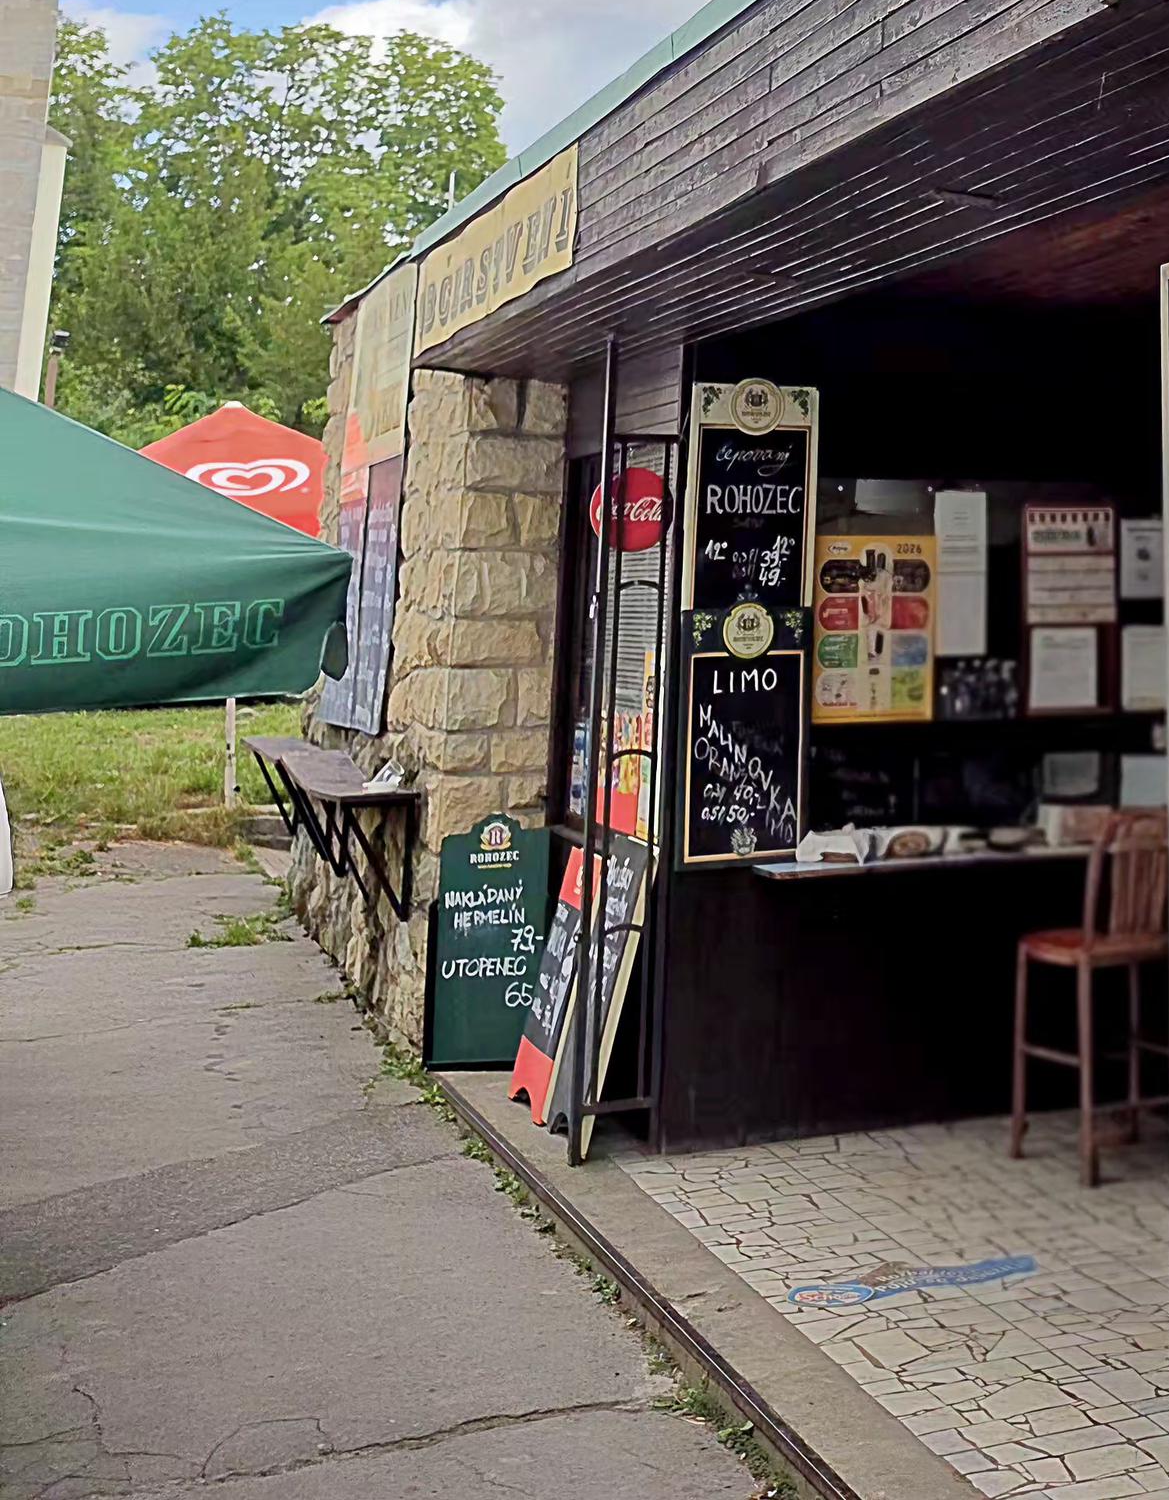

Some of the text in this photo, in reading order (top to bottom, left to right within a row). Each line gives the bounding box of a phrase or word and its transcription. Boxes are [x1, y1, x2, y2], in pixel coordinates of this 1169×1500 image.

[705, 483, 803, 515] ROHOZEC
[712, 667, 778, 695] LIMO
[698, 703, 798, 822] MALINOVKA
[469, 850, 520, 864] ROHOZEC
[444, 878, 524, 909] NAKLÁDANÝ
[453, 903, 525, 930] HERMELÍN
[440, 956, 527, 979] UTOPENEC
